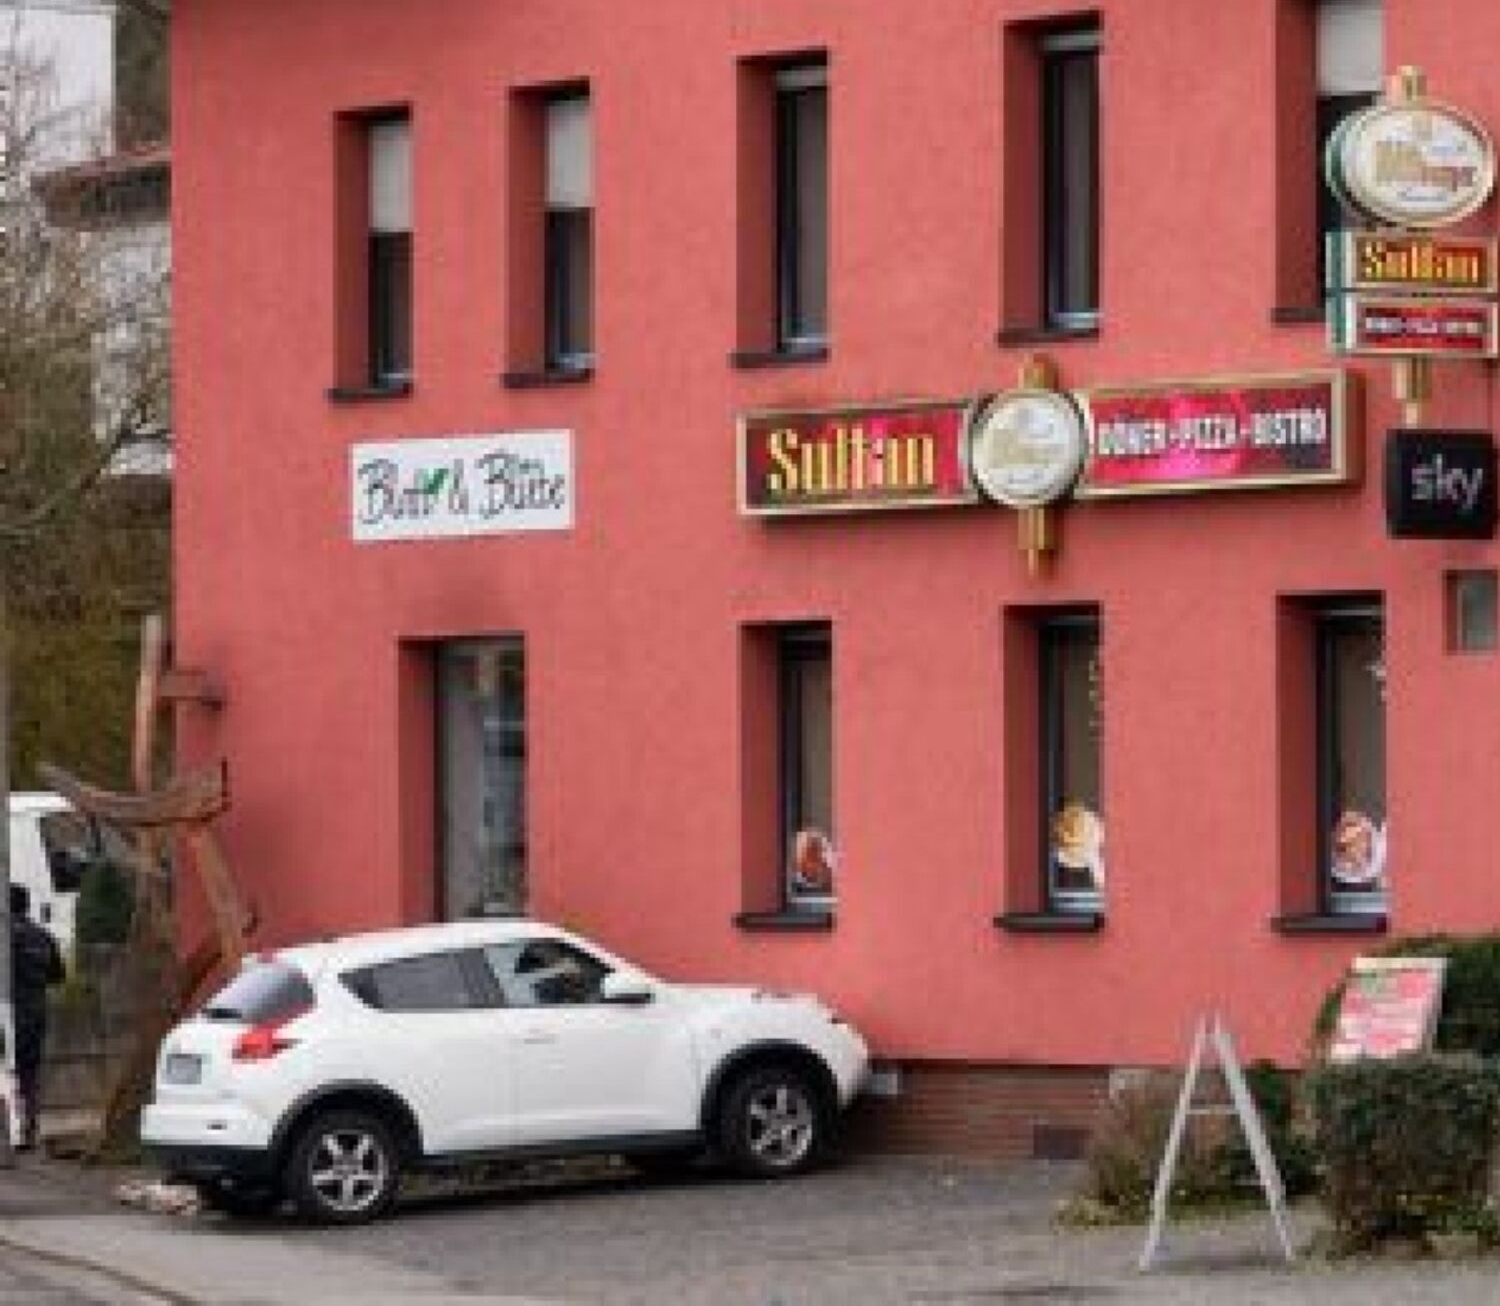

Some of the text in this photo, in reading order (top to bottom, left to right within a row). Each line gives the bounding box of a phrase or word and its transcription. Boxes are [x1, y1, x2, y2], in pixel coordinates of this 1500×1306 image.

[1364, 243, 1478, 282] Sultan
[766, 427, 934, 491] Sultan
[1411, 454, 1483, 511] sky
